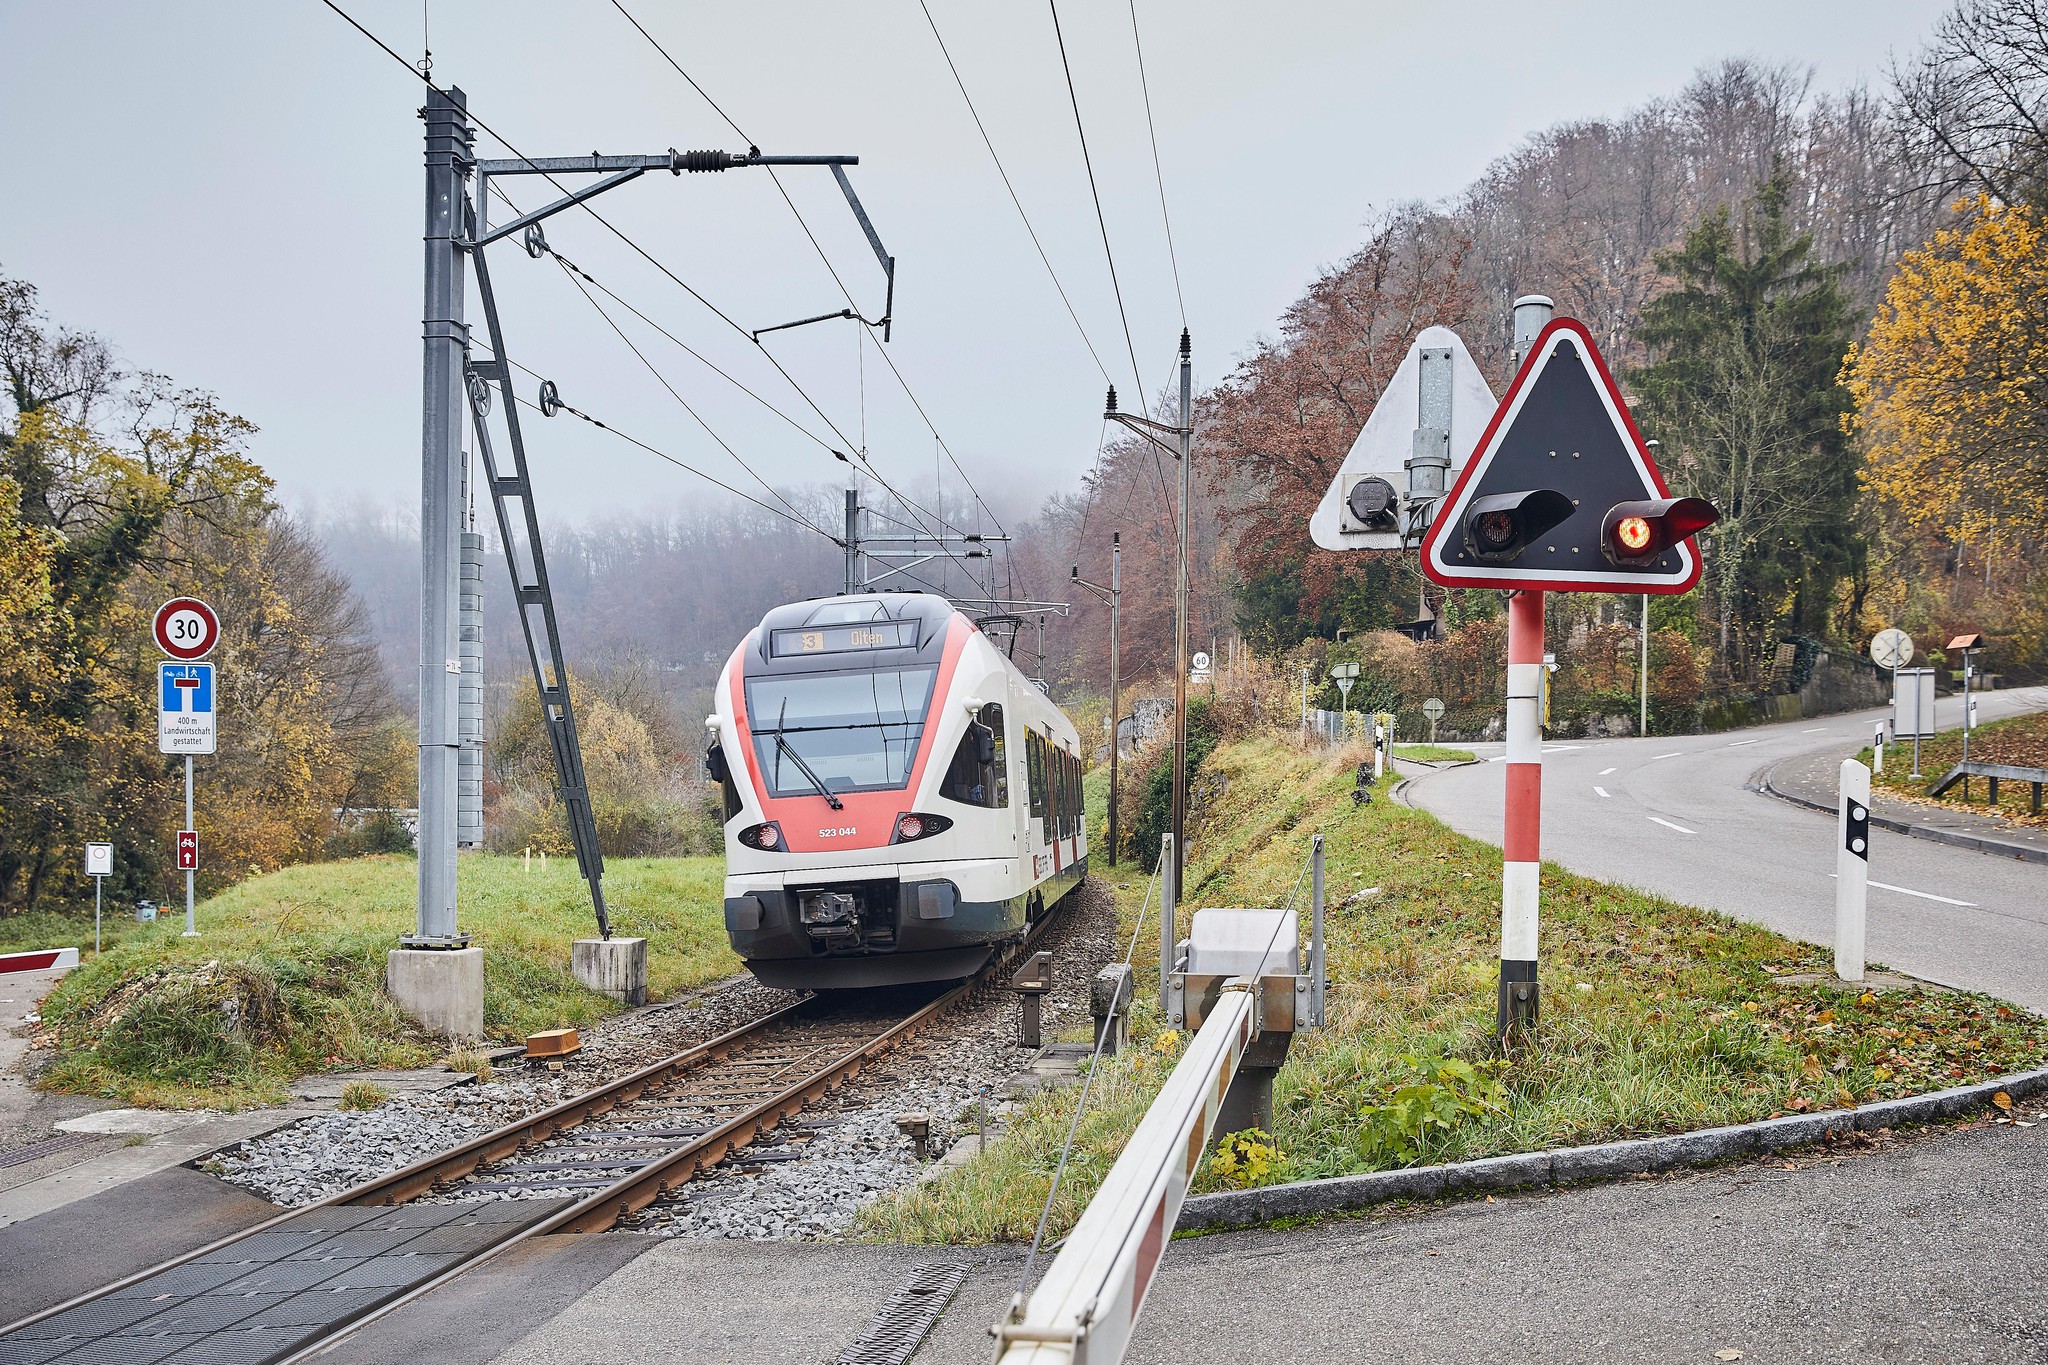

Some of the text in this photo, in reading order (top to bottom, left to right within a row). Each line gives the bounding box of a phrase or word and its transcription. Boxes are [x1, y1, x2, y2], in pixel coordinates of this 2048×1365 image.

[174, 619, 199, 639] 30
[850, 629, 883, 645] Olten
[1196, 656, 1206, 665] 60
[177, 716, 190, 725] 400
[164, 726, 211, 735] Landwirtschaft
[173, 737, 202, 746] gestattet
[819, 827, 857, 838] 523 044
